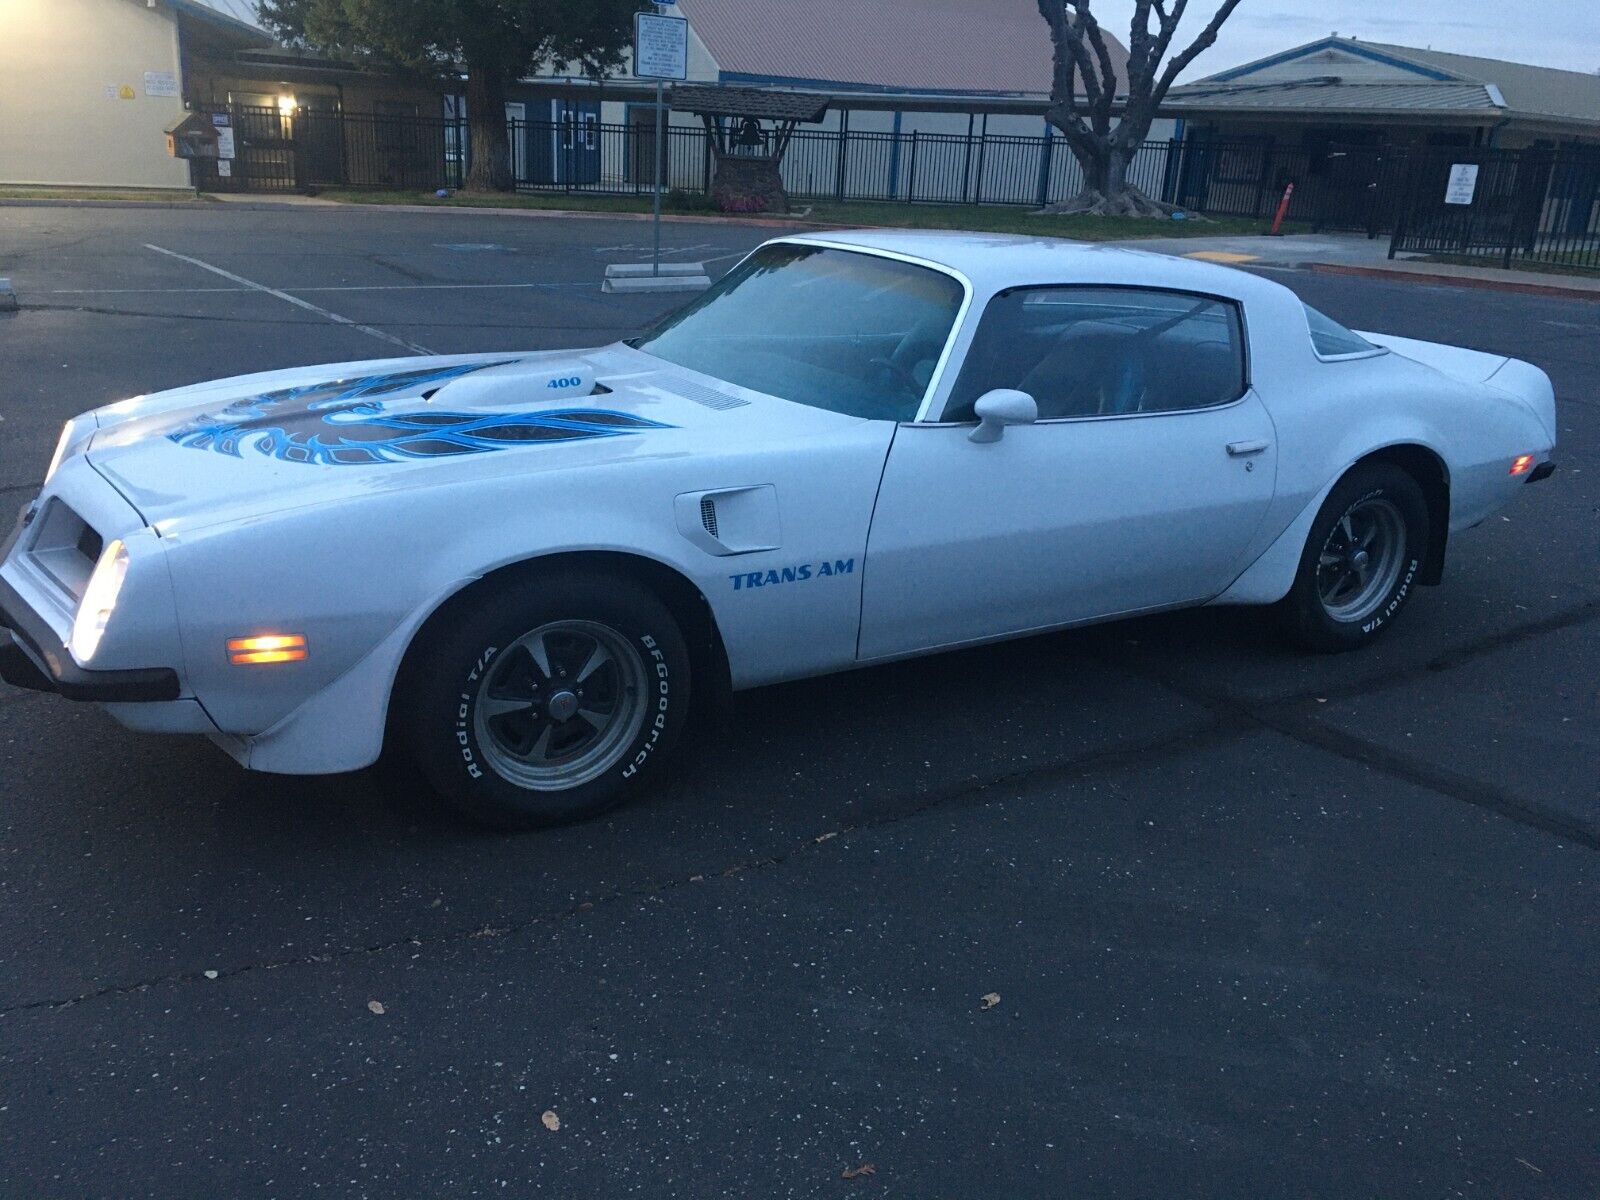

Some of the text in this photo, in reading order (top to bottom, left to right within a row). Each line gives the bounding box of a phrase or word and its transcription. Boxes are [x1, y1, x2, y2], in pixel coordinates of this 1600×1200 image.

[547, 377, 582, 389] 400
[729, 558, 855, 590] TRANS AM
[1362, 559, 1418, 634] Radial T/A
[456, 645, 498, 779] Radial T/A
[621, 634, 669, 779] BFGoodrich
